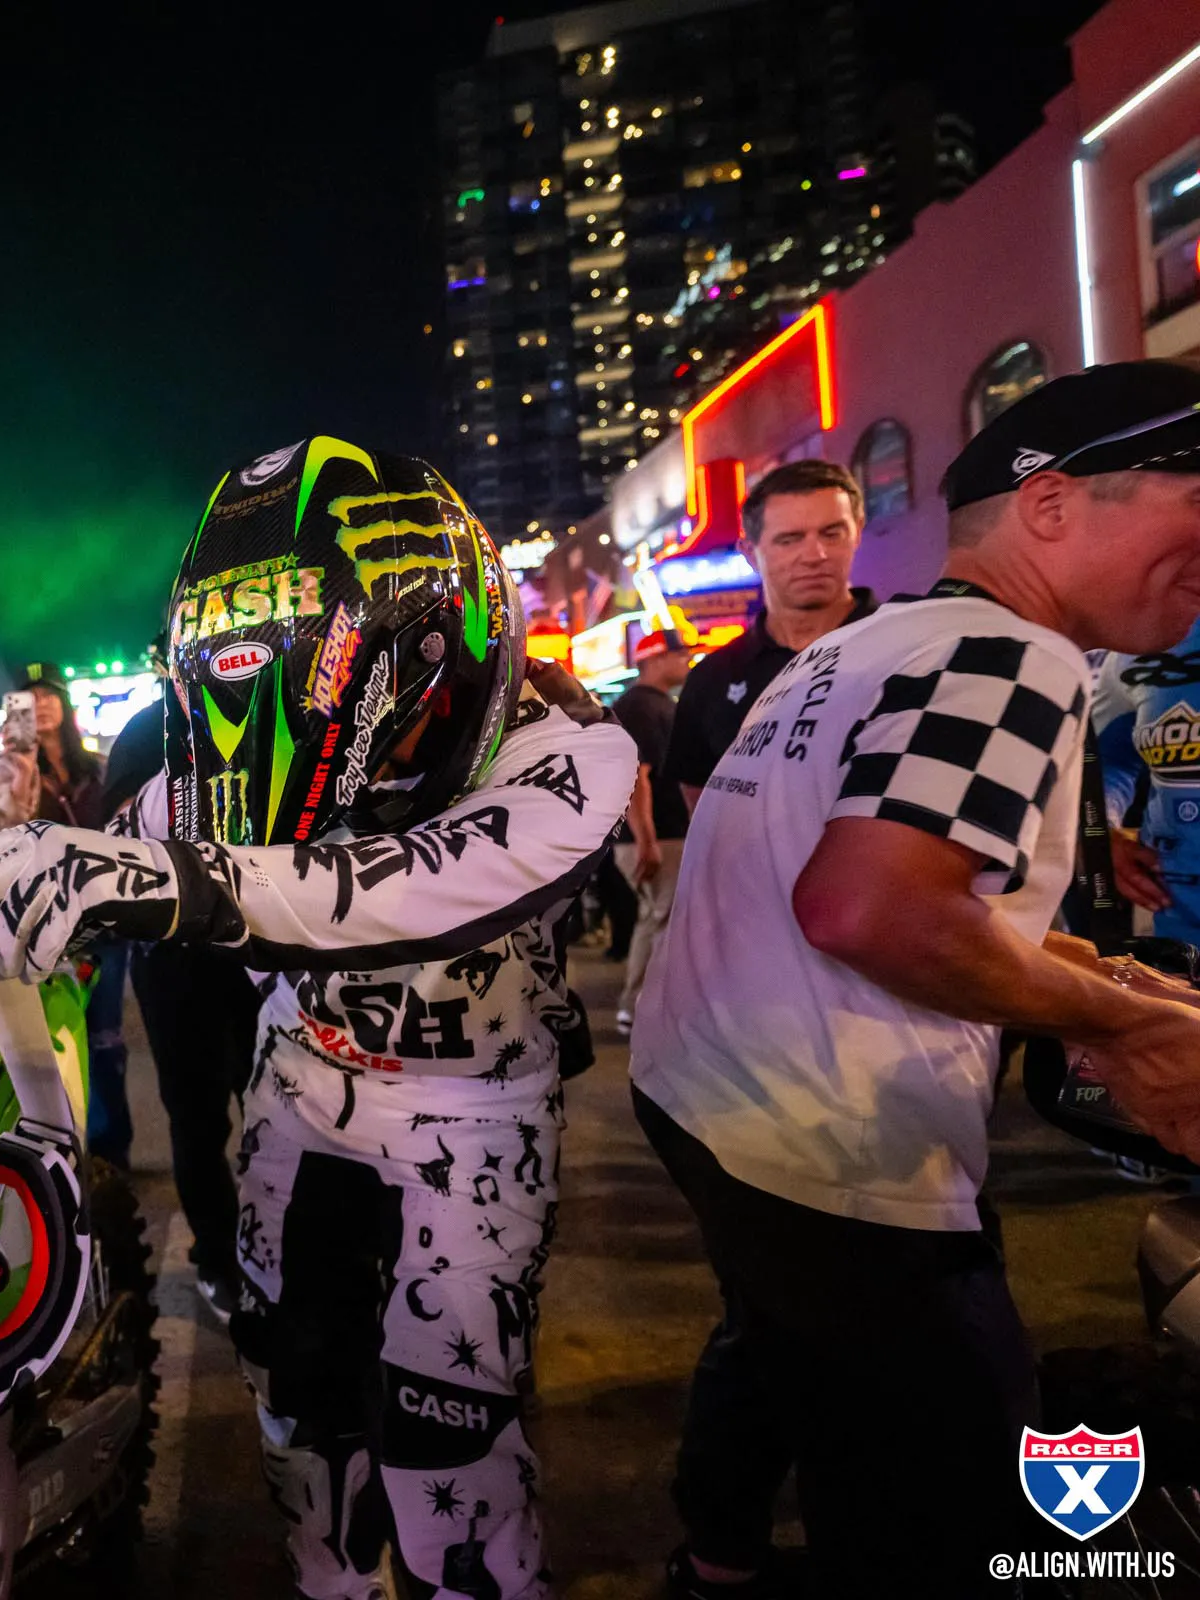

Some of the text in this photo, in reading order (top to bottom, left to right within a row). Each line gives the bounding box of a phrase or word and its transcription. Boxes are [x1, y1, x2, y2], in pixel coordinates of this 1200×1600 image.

[172, 566, 326, 646] CASH
[218, 651, 262, 672] BELL
[313, 601, 353, 718] HOLESHOT
[330, 628, 363, 708] KING
[336, 651, 390, 806] Troy Lee Designs
[294, 722, 342, 841] ONE NIGHT ONLY
[398, 1386, 490, 1432] CASH
